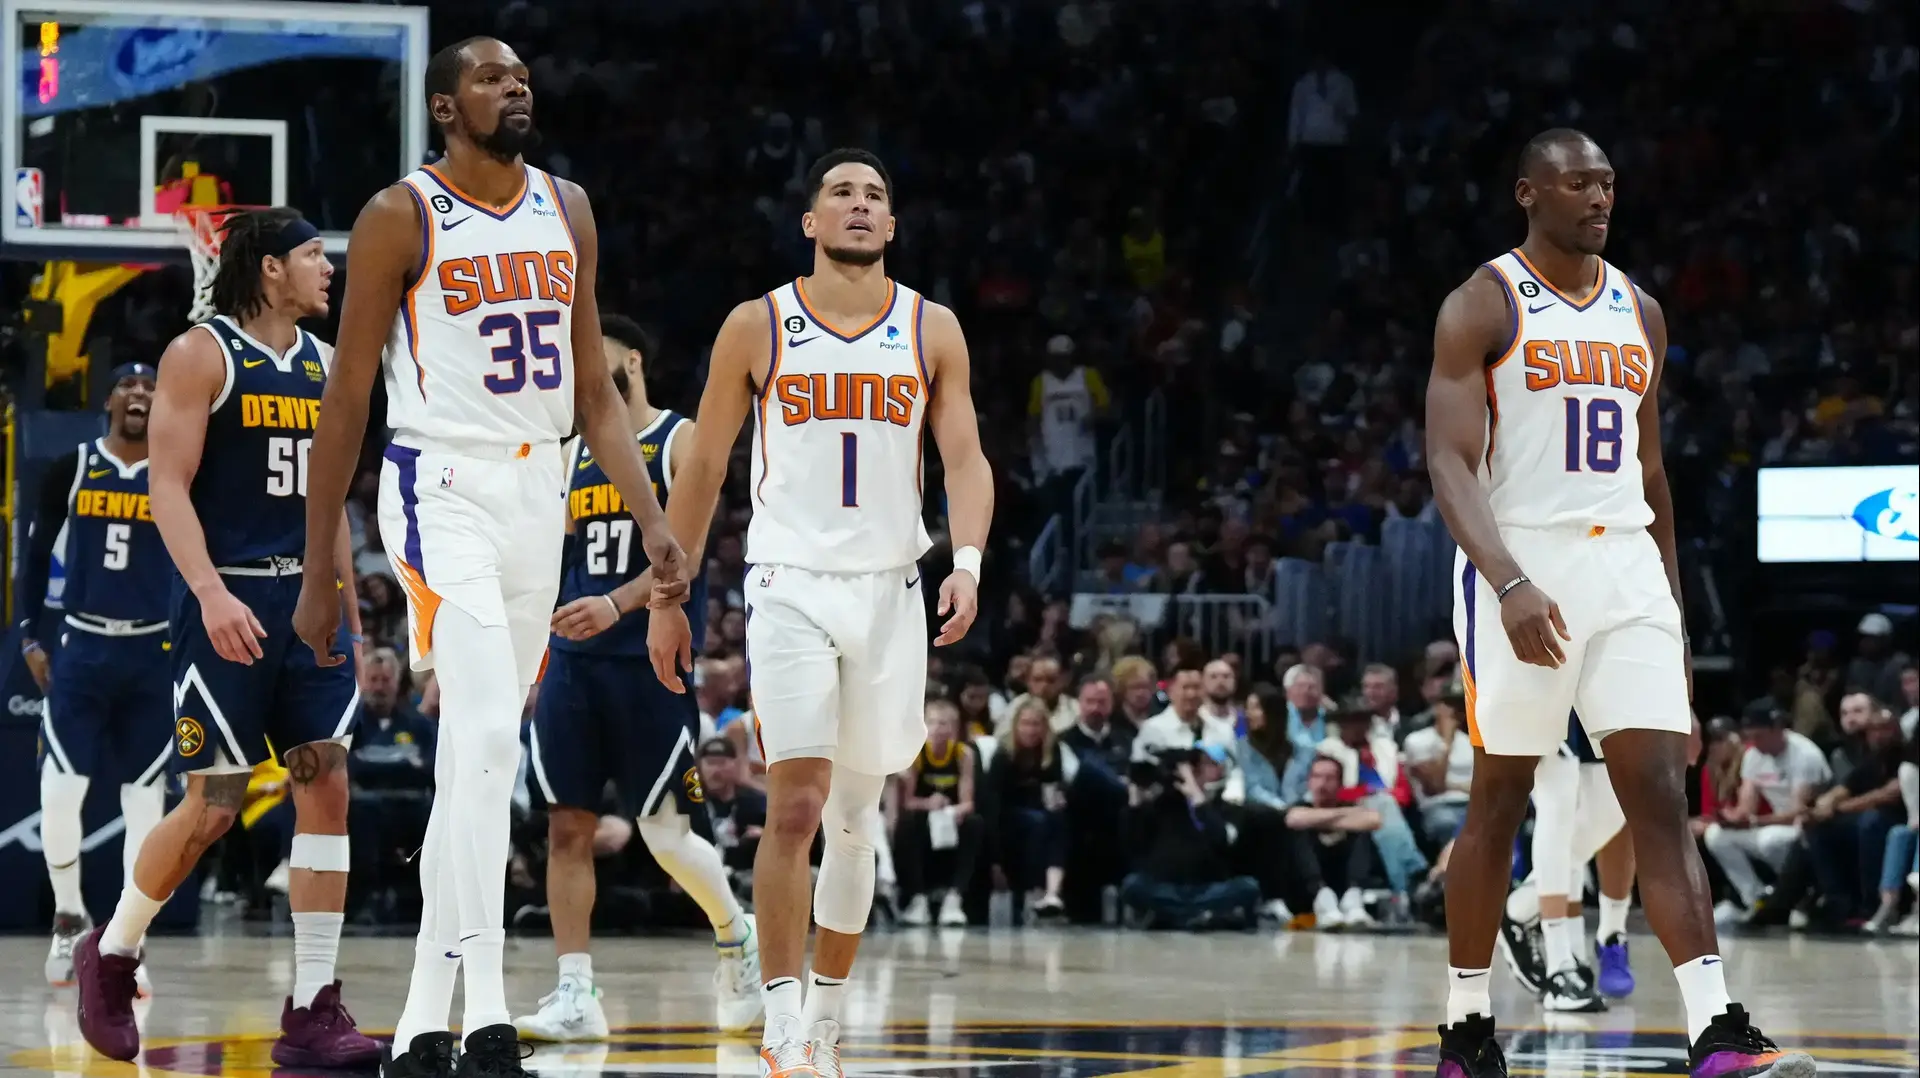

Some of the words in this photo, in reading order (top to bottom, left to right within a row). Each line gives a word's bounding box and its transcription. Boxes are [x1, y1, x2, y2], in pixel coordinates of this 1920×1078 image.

[433, 197, 450, 213] 6
[532, 208, 557, 217] PayPal
[437, 250, 574, 317] SUNS
[1522, 283, 1536, 296] 6
[789, 318, 801, 332] 6
[1609, 304, 1633, 314] PayPal
[230, 338, 244, 351] 6
[478, 309, 562, 395] 35
[879, 342, 908, 351] PayPal
[1523, 339, 1648, 397] SUNS
[775, 373, 919, 428] SUNS
[1563, 396, 1623, 473] 18
[840, 431, 860, 508] 1
[76, 489, 155, 522] DENVE
[569, 483, 657, 520] DENV
[103, 523, 132, 571] 5
[586, 519, 633, 575] 27
